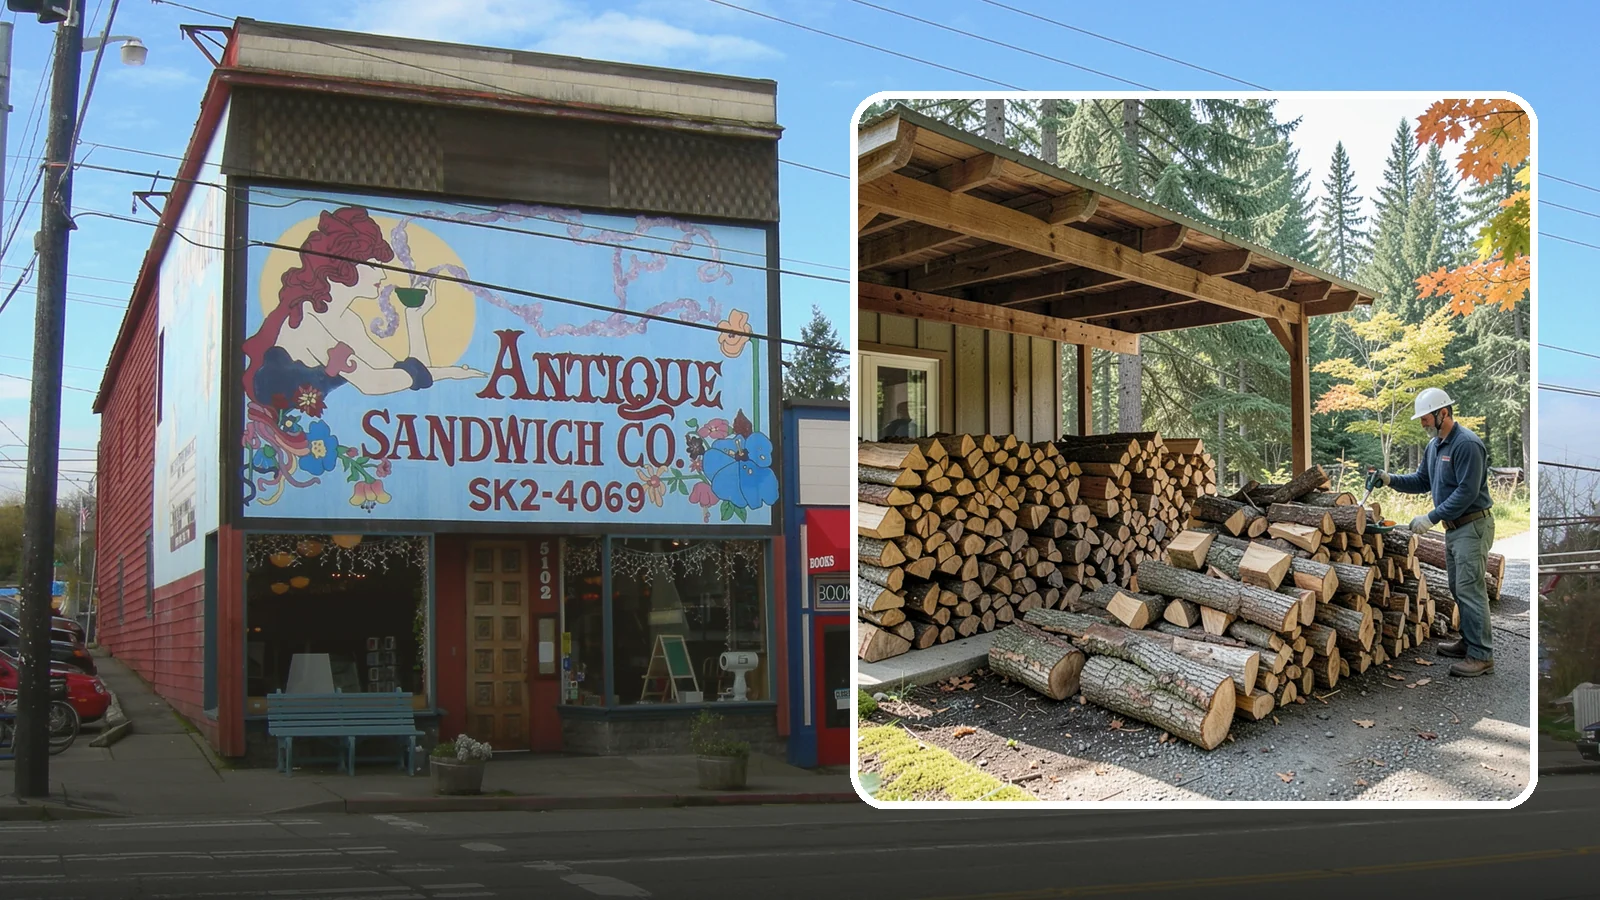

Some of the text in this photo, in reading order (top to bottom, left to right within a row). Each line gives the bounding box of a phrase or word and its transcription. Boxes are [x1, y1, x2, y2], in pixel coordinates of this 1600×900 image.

[475, 329, 723, 420] ANTIQUE
[361, 408, 684, 469] SANDWICH CO.
[468, 477, 646, 513] SK2-4069
[540, 542, 551, 599] 5102
[809, 555, 835, 569] BOOKS
